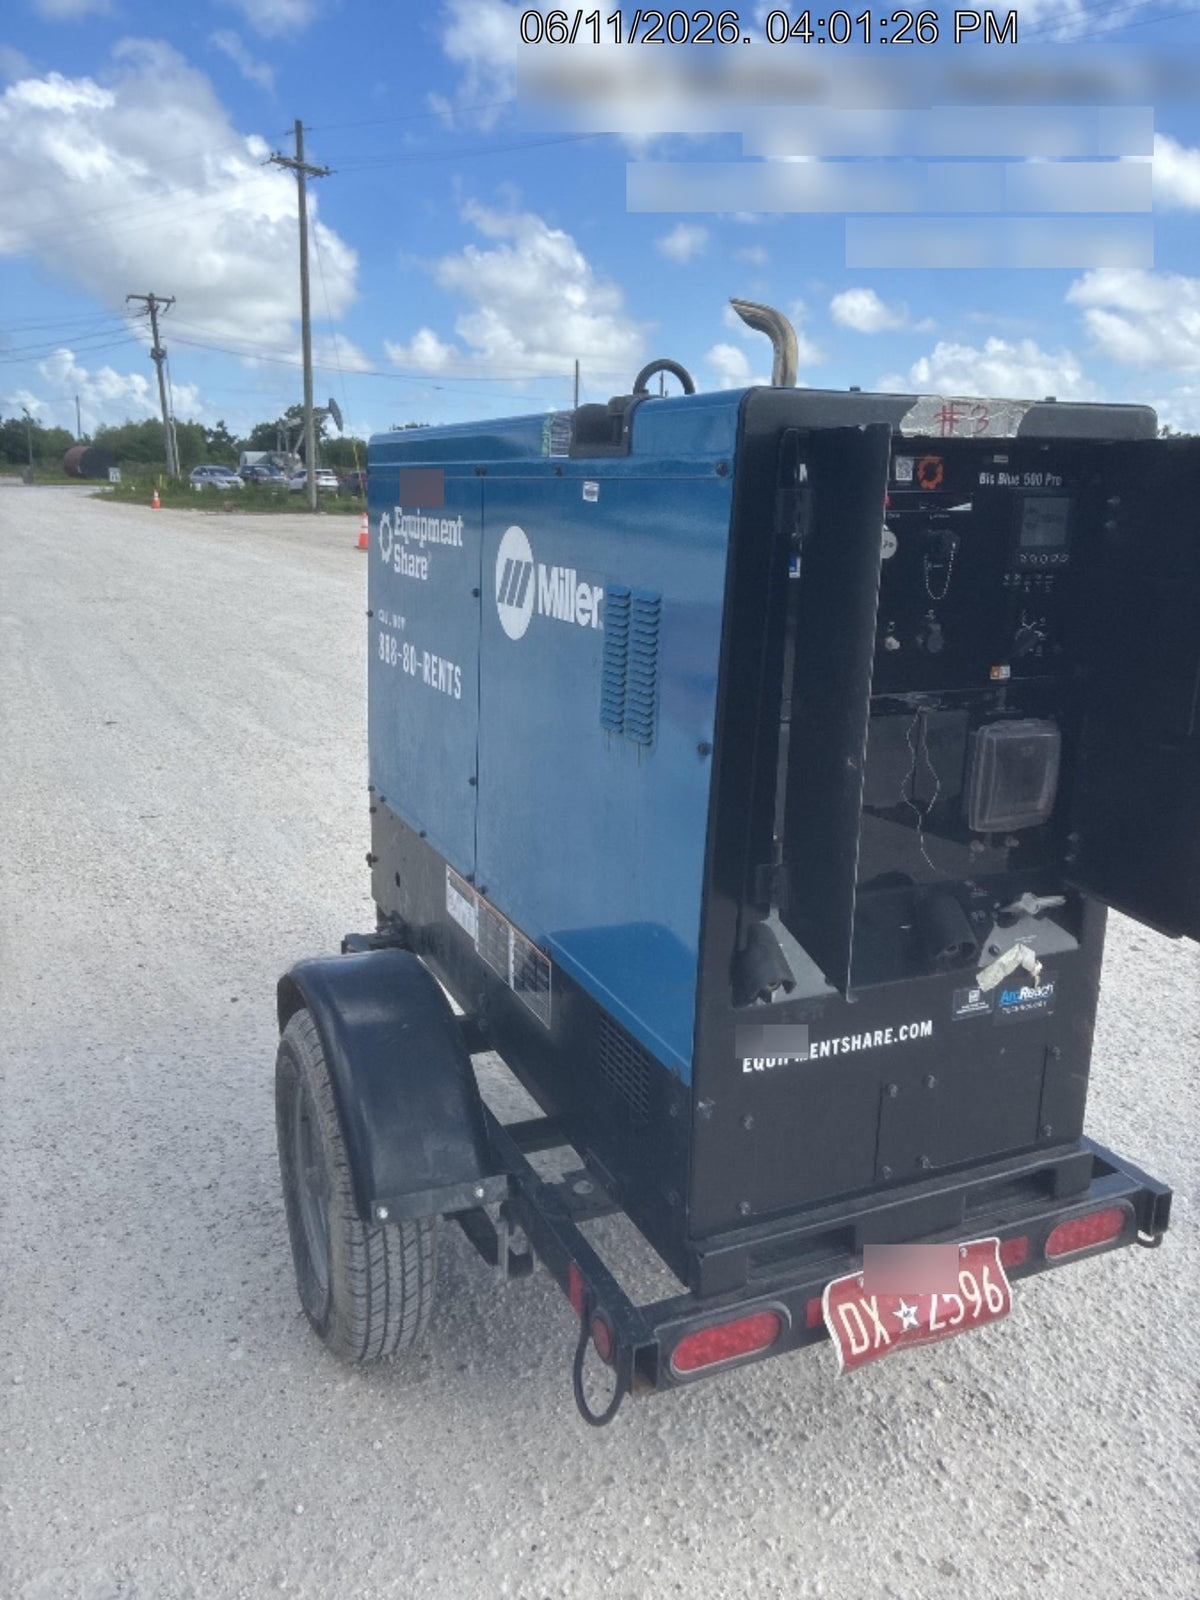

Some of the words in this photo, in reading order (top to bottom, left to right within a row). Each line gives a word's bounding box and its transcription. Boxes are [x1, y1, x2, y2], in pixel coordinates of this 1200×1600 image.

[394, 506, 463, 548] Equipment
[394, 543, 428, 580] Share
[837, 1295, 892, 1355] DX
